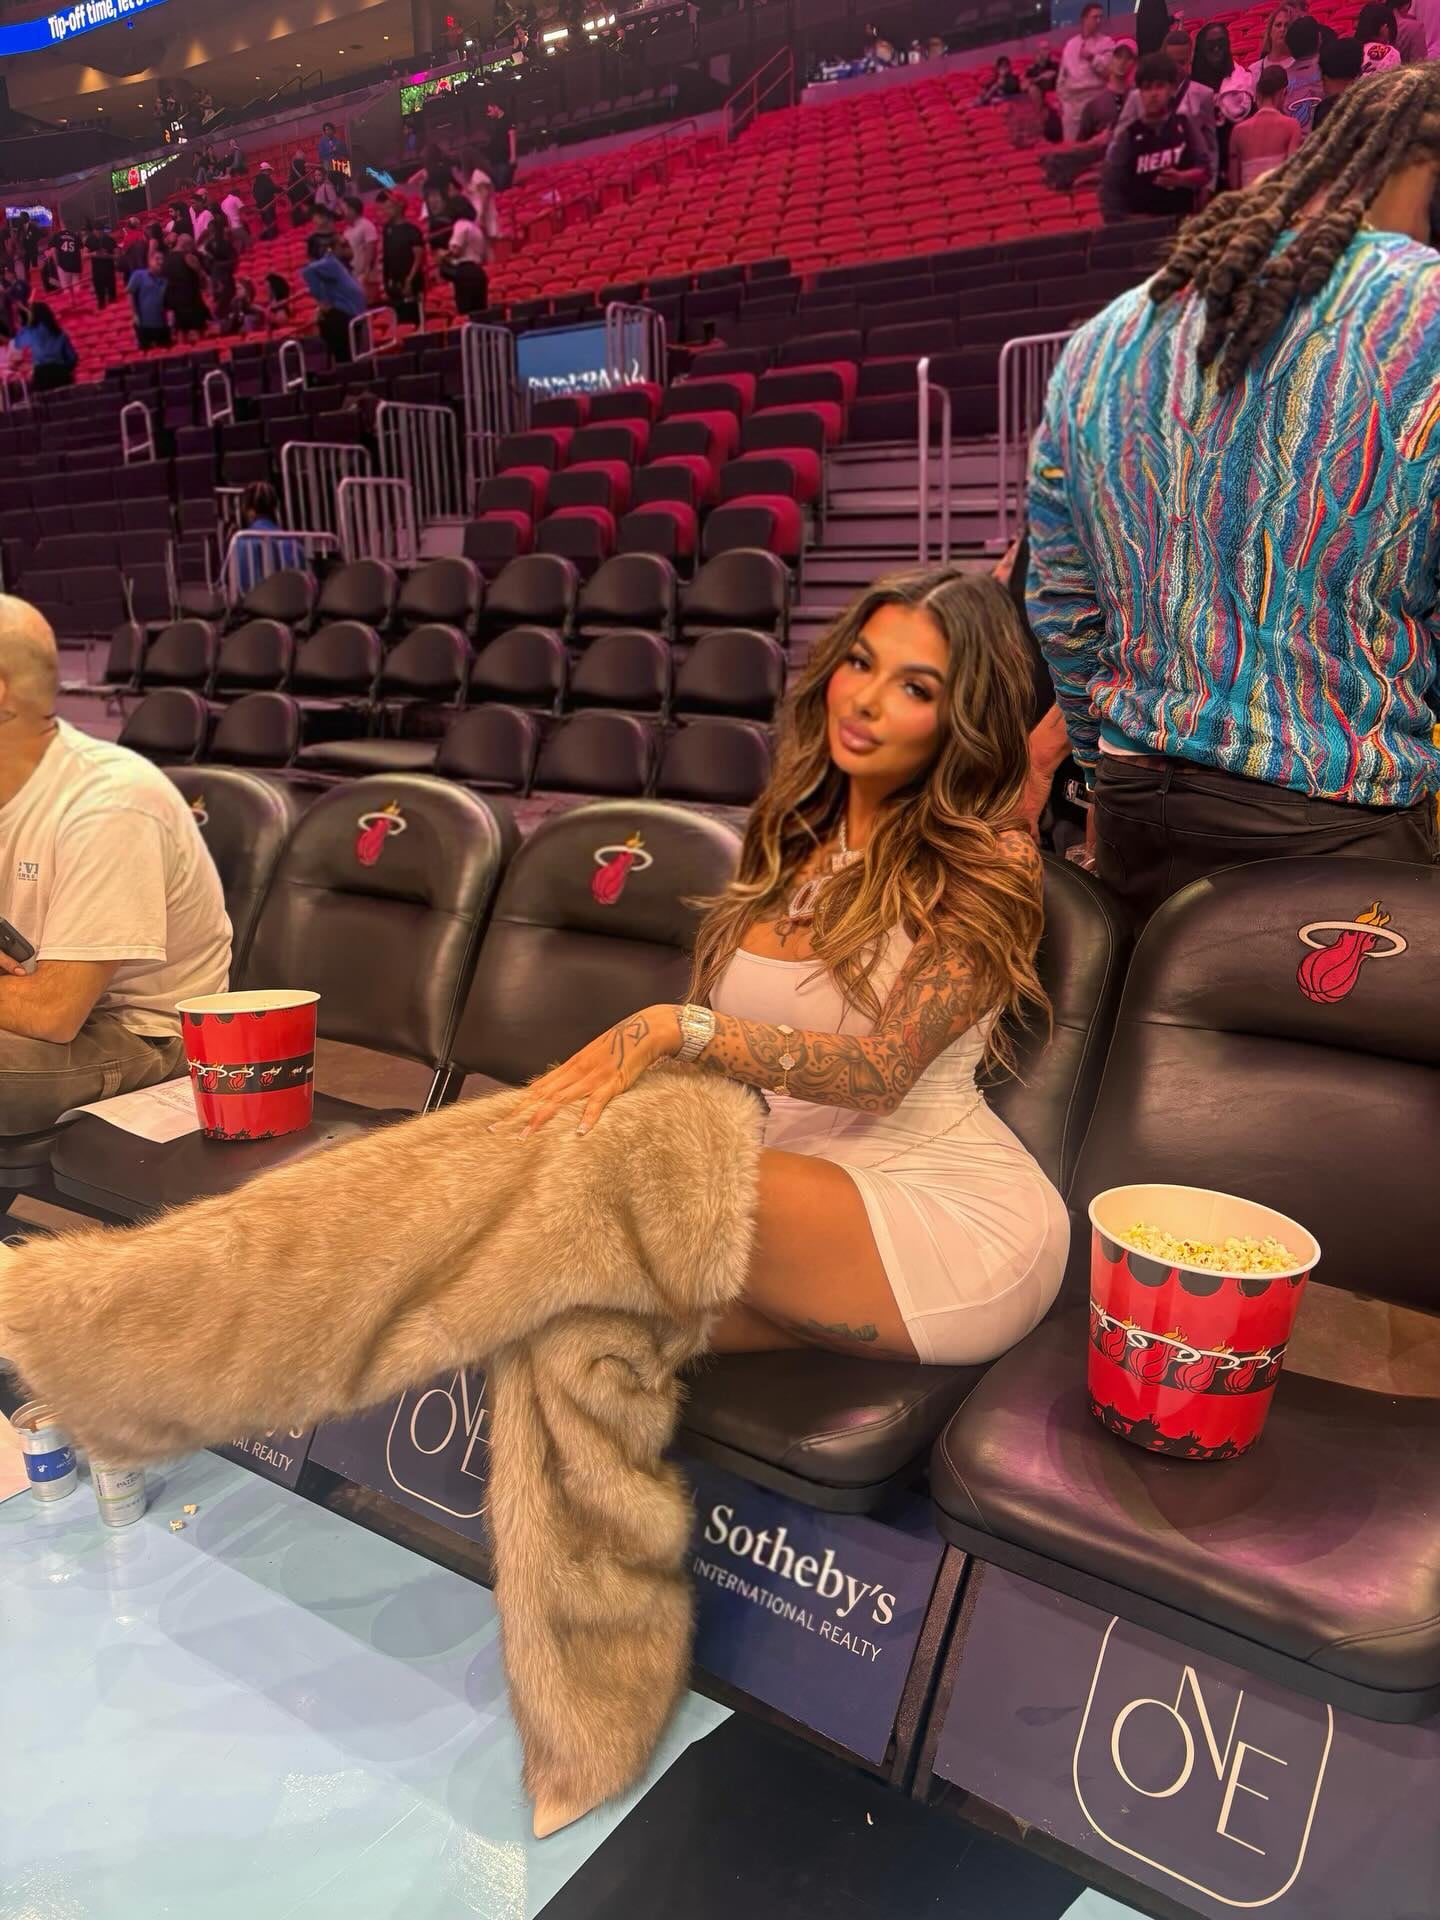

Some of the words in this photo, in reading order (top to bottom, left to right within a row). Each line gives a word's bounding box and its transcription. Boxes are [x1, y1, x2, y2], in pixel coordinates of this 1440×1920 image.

[47, 4, 86, 40] Tip-off
[86, 0, 117, 25] time,
[1136, 142, 1186, 174] HEAT
[61, 241, 75, 252] 45
[251, 1441, 294, 1472] REALTY
[410, 1364, 490, 1482] ONE
[704, 1504, 897, 1626] Sotheby's
[692, 1557, 816, 1632] INTERNATIONAL
[819, 1619, 883, 1662] REALTY
[1111, 1664, 1288, 1856] ONE
